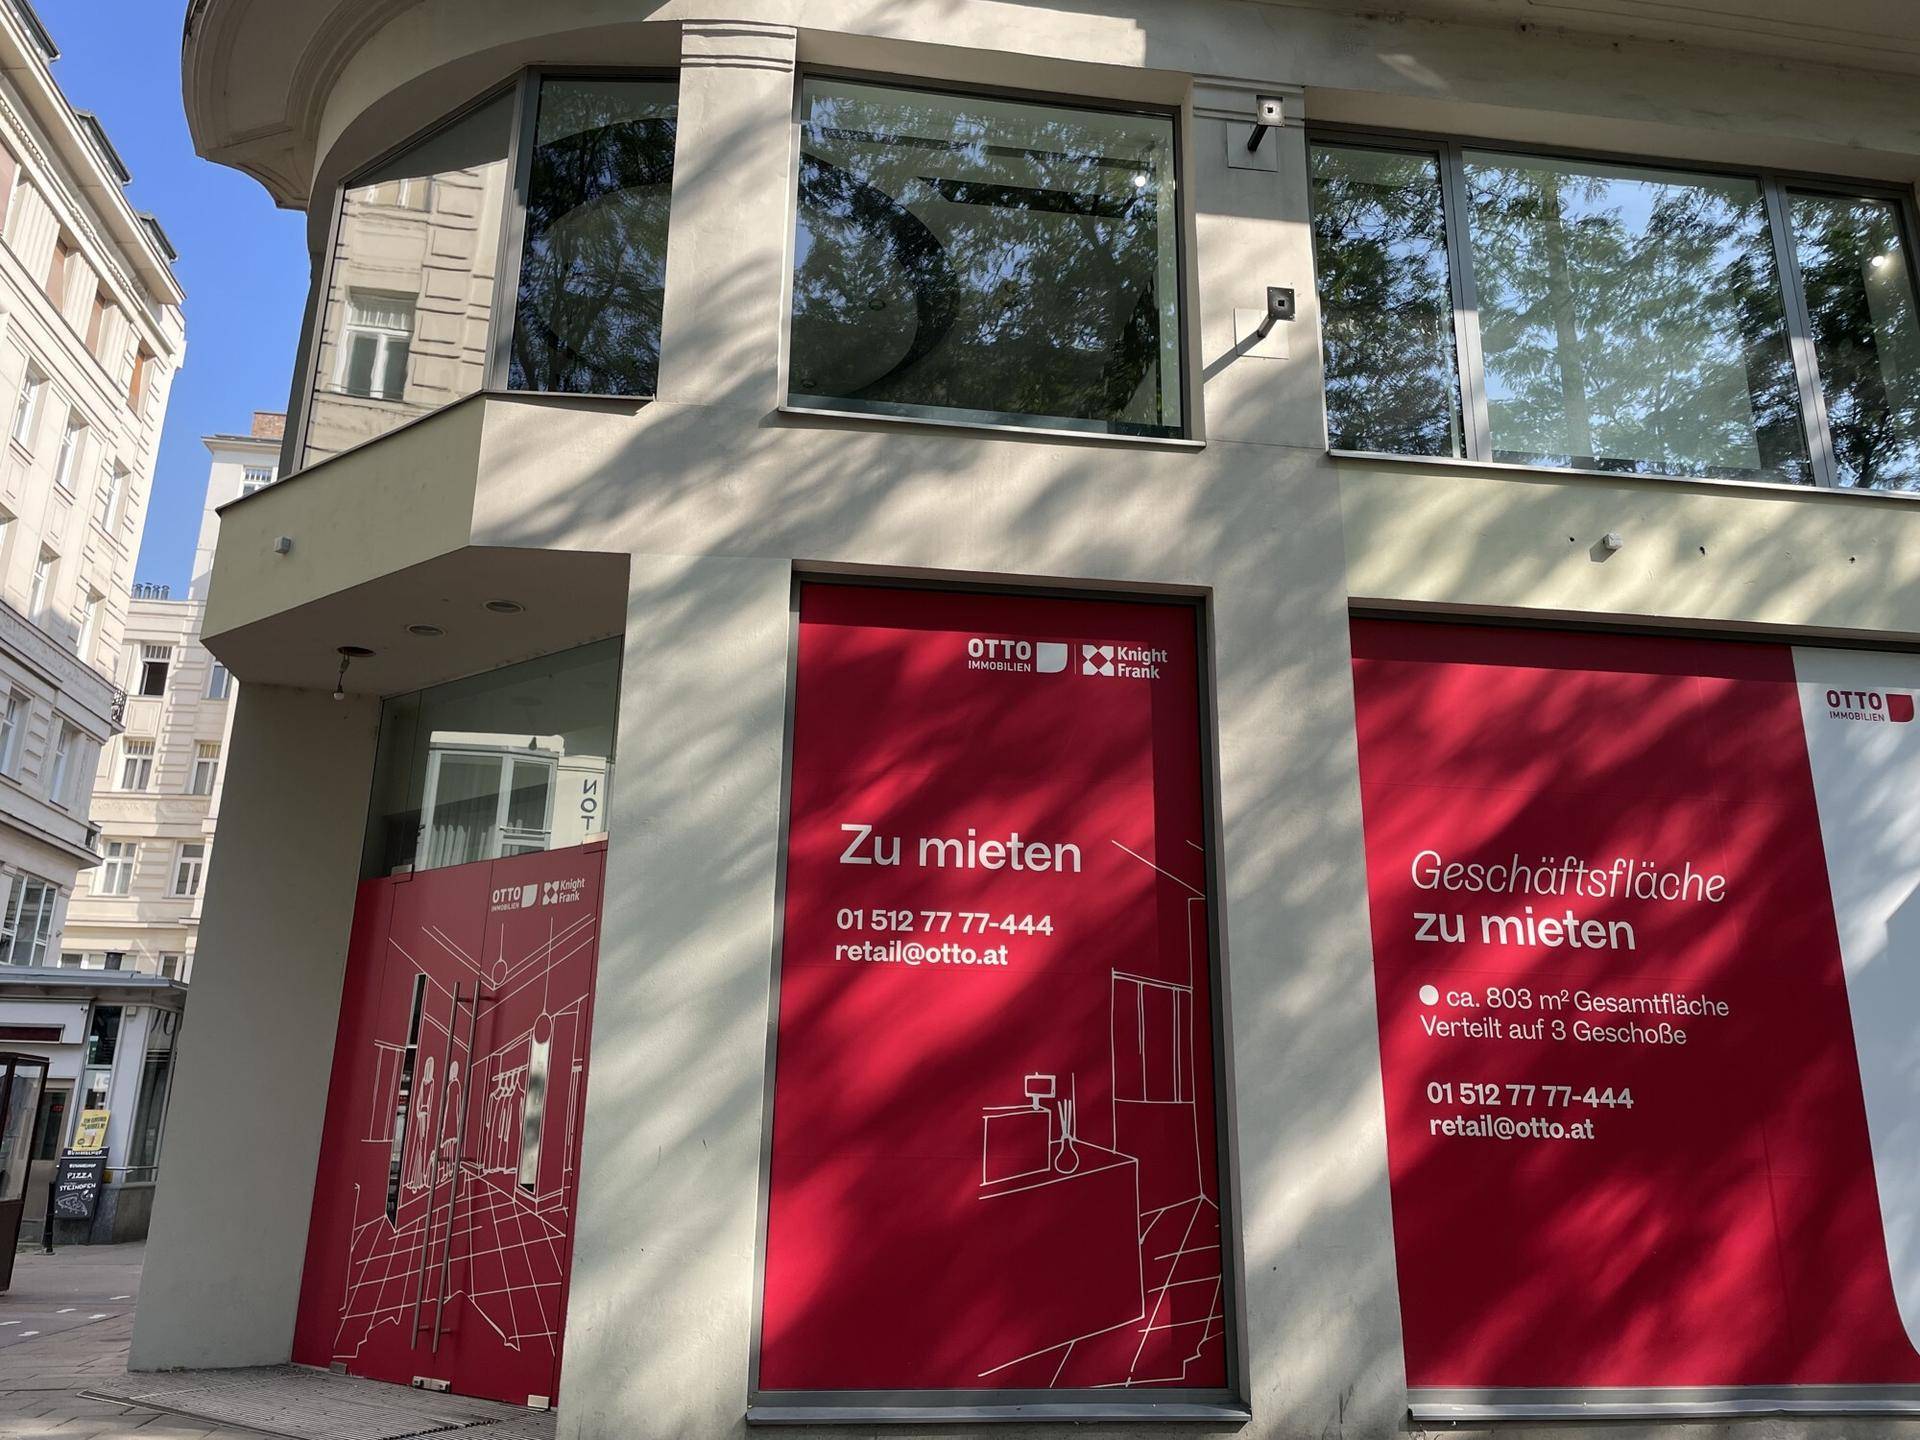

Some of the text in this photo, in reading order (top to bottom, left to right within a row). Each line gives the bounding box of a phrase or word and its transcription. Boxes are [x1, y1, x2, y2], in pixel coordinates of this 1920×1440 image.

[968, 638, 1031, 660] OTTO
[1117, 646, 1168, 666] Knight
[968, 660, 1031, 673] IMMOBILIEN
[1117, 663, 1161, 679] Frank
[1826, 689, 1883, 710] OTTO
[1829, 711, 1885, 722] IMMOBILIEN
[839, 823, 1082, 873] Zu mieten
[559, 878, 586, 892] Knight
[1411, 850, 1727, 903] Geschäftsfläche
[492, 886, 521, 904] OTTO
[559, 891, 580, 903] Frank
[836, 908, 1054, 936] 01 512 77 77-444
[1413, 906, 1636, 950] zu mieten
[835, 940, 1008, 966] retail@otto.at
[1446, 987, 1730, 1017] ca. 803 m² Gesamtfläche
[1420, 1014, 1688, 1045] Verteilt auf 3 Geschoße
[1426, 1081, 1634, 1110] 01 512 77 77-444
[1429, 1114, 1595, 1141] retail@otto.at
[66, 1172, 93, 1180] PIZZA
